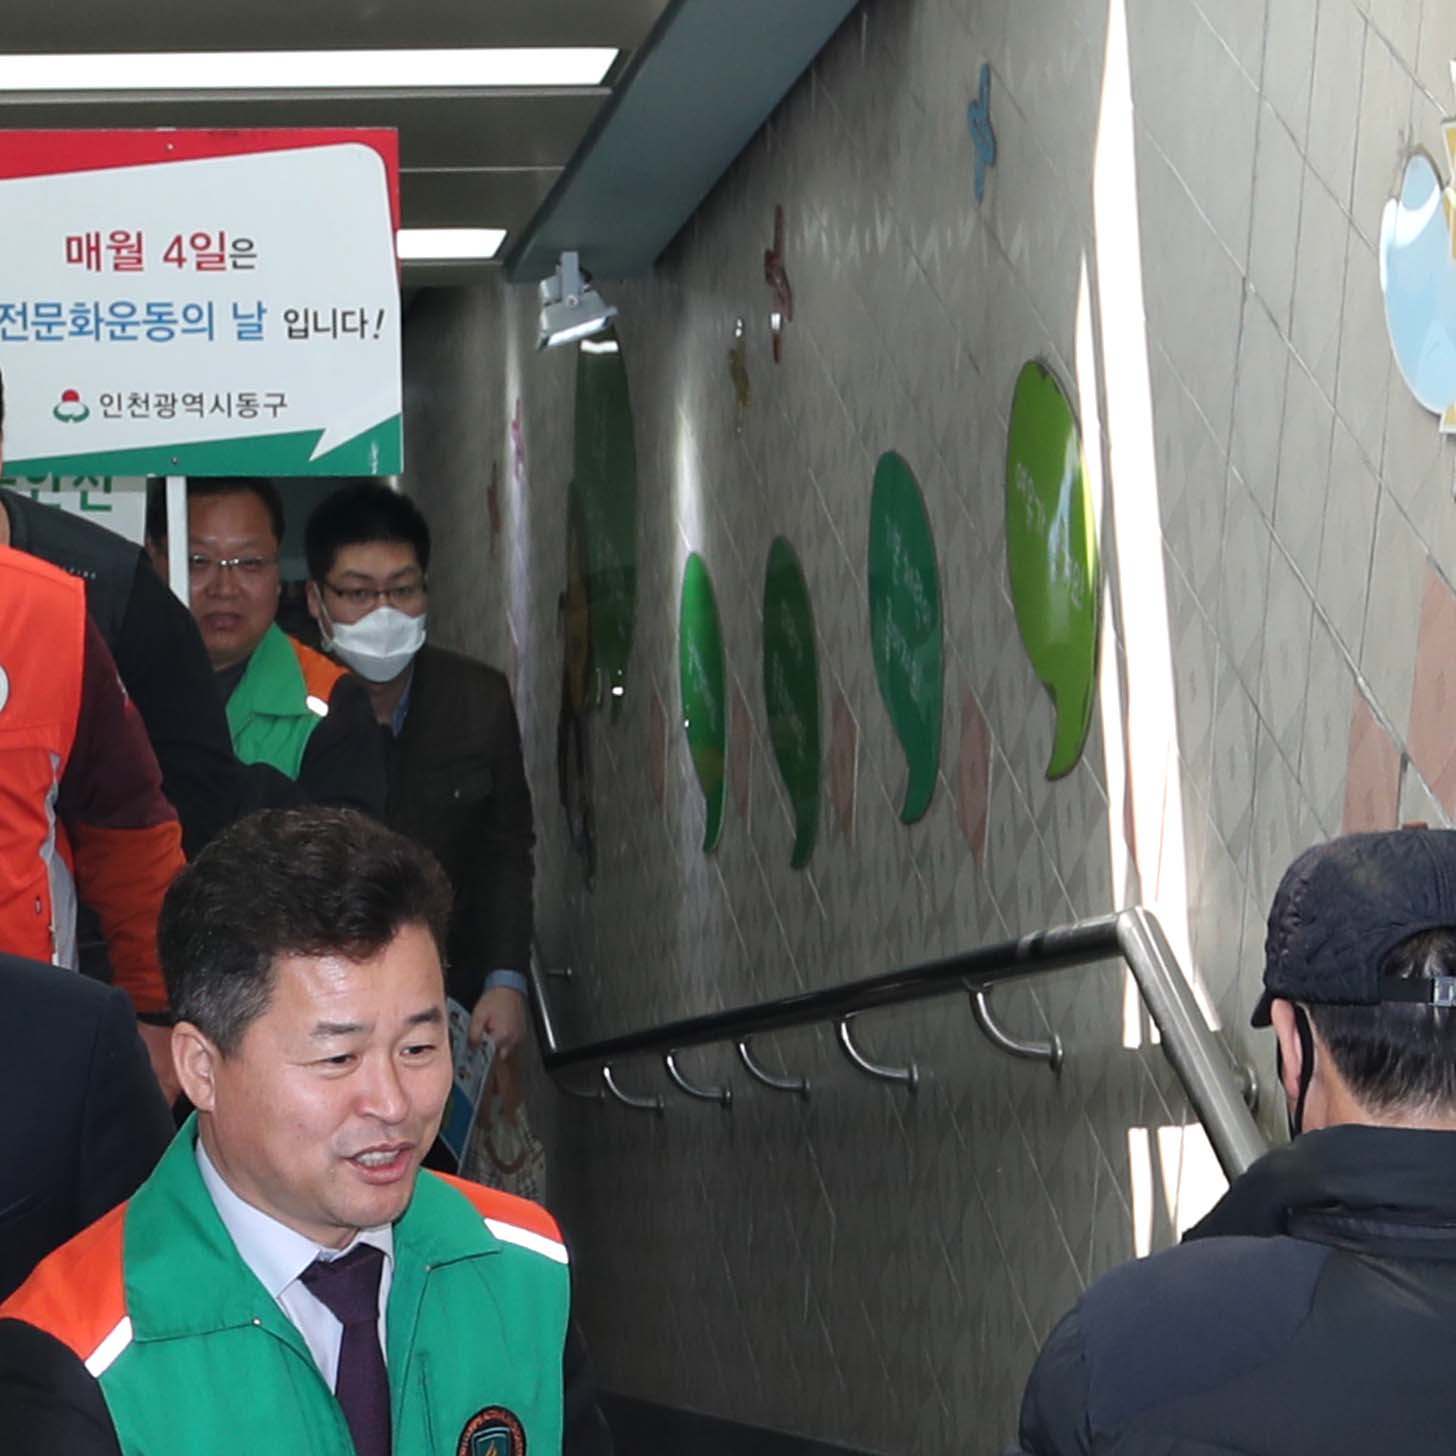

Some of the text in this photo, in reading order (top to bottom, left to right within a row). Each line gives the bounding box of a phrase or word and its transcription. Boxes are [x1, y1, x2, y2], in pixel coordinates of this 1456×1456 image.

[64, 229, 259, 273] 매월 4일은
[231, 299, 268, 343] 날
[282, 306, 386, 341] 입니다!
[99, 391, 289, 420] 인천광역시동구
